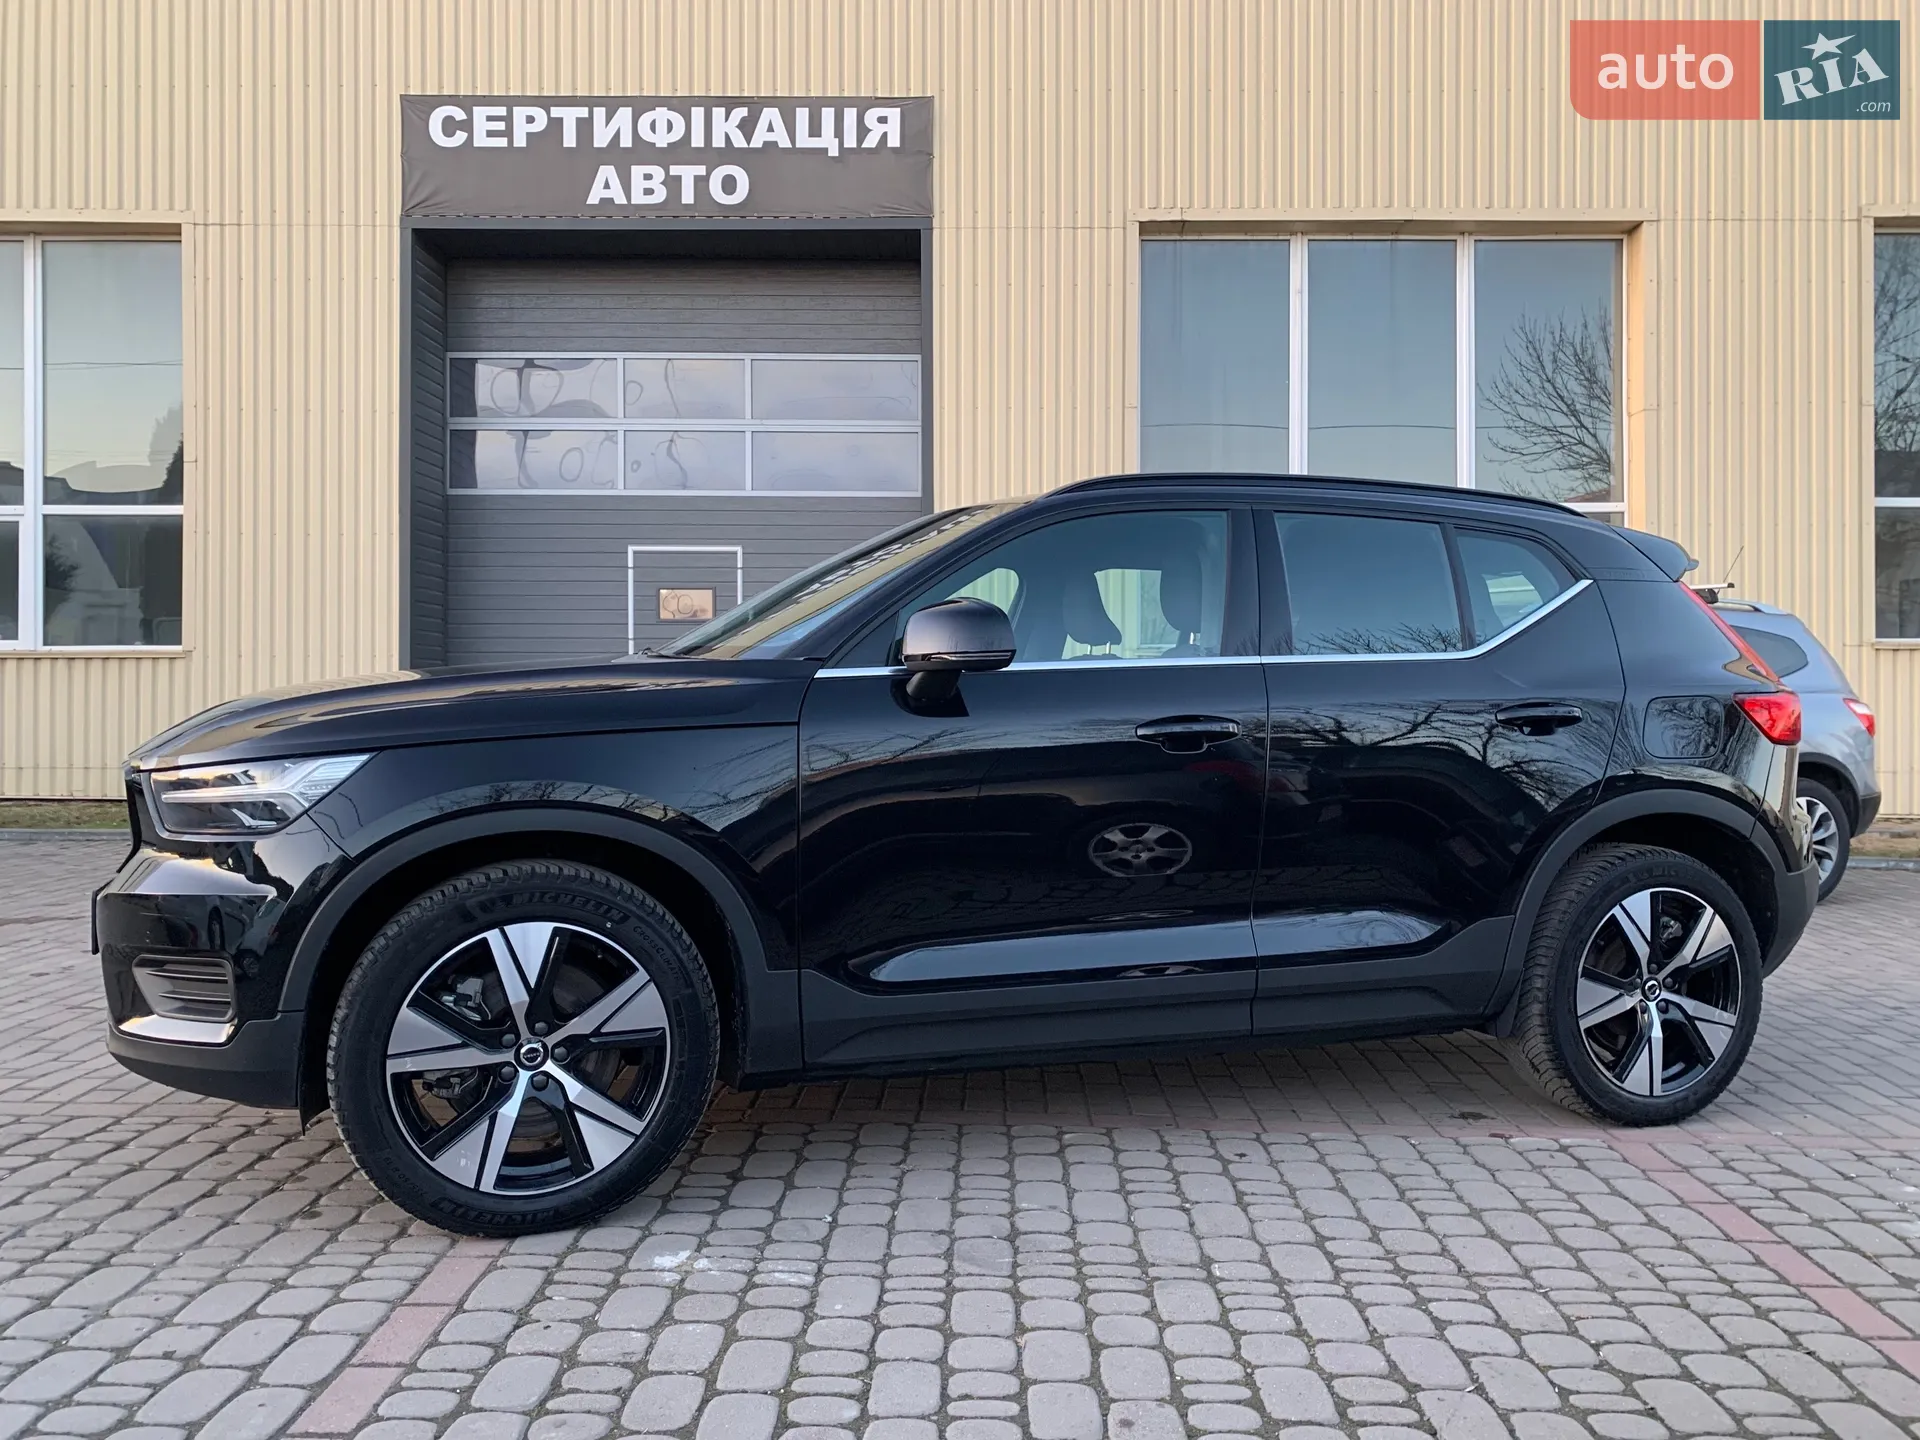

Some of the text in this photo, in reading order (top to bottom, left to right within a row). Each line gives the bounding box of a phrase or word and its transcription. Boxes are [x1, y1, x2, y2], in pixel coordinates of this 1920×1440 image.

[428, 105, 902, 157] СЕРТИФІКАЦІЯ
[586, 164, 750, 206] АВТО
[511, 891, 626, 922] MICHELIN
